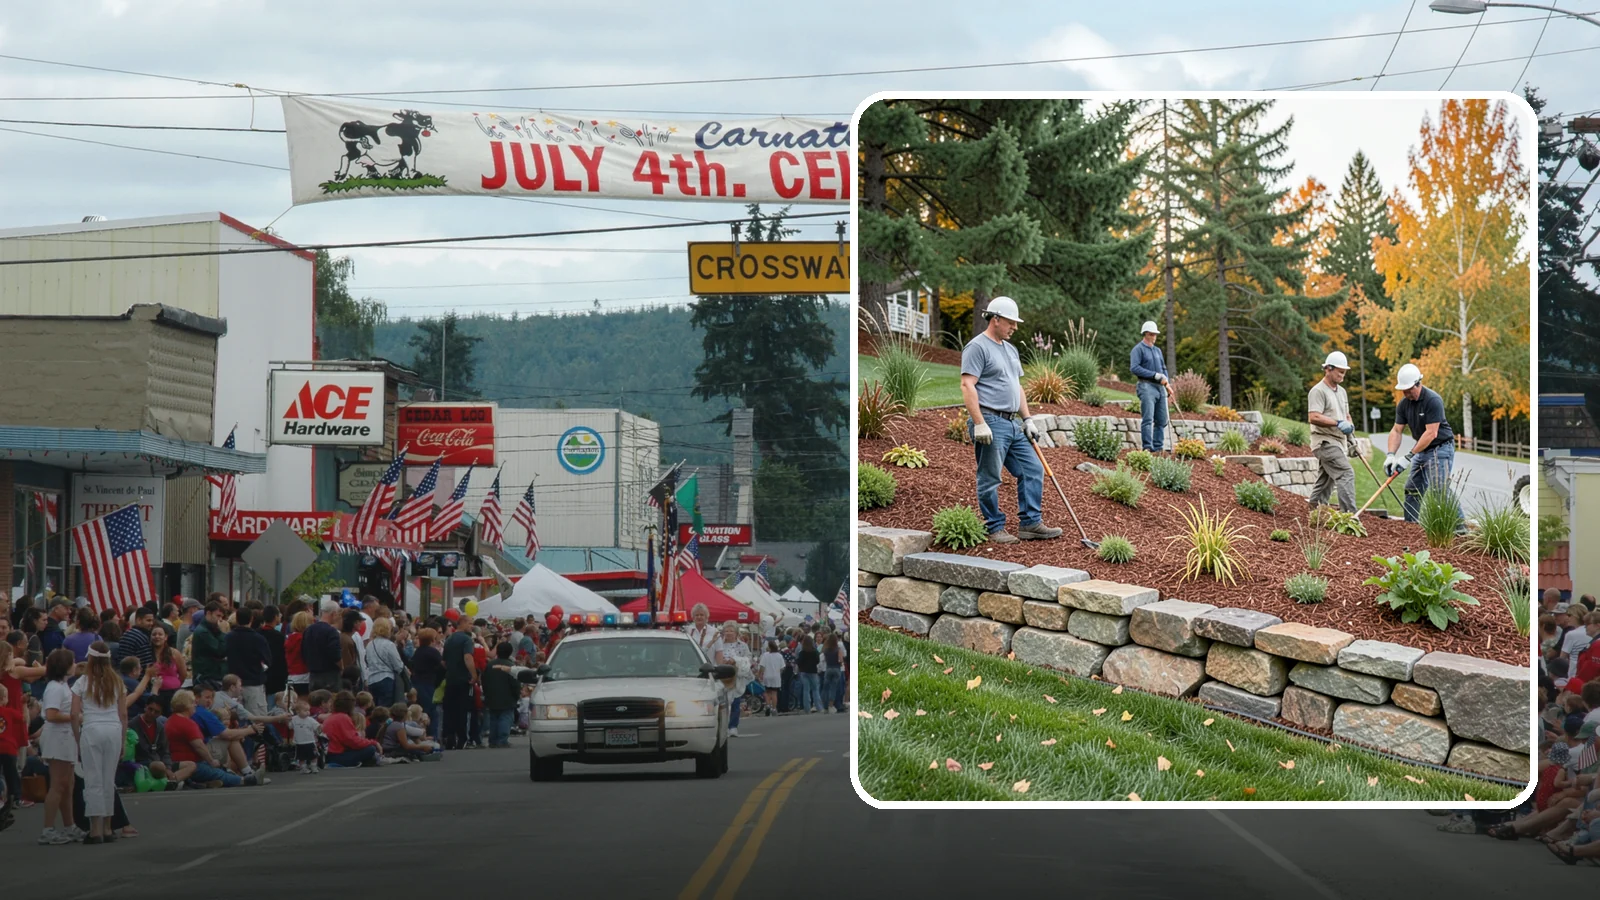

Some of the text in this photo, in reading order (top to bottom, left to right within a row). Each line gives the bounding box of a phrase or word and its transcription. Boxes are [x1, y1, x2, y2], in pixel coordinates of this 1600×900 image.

[481, 141, 604, 192] JULY
[632, 150, 746, 197] 4th.
[697, 254, 850, 280] CROSSWA
[283, 380, 373, 419] ACE
[284, 421, 370, 436] Hardware
[96, 485, 124, 494] Vincent
[126, 486, 136, 494] de
[137, 486, 155, 494] Paul
[688, 526, 741, 535] CRNATION
[699, 535, 730, 543] GLASS
